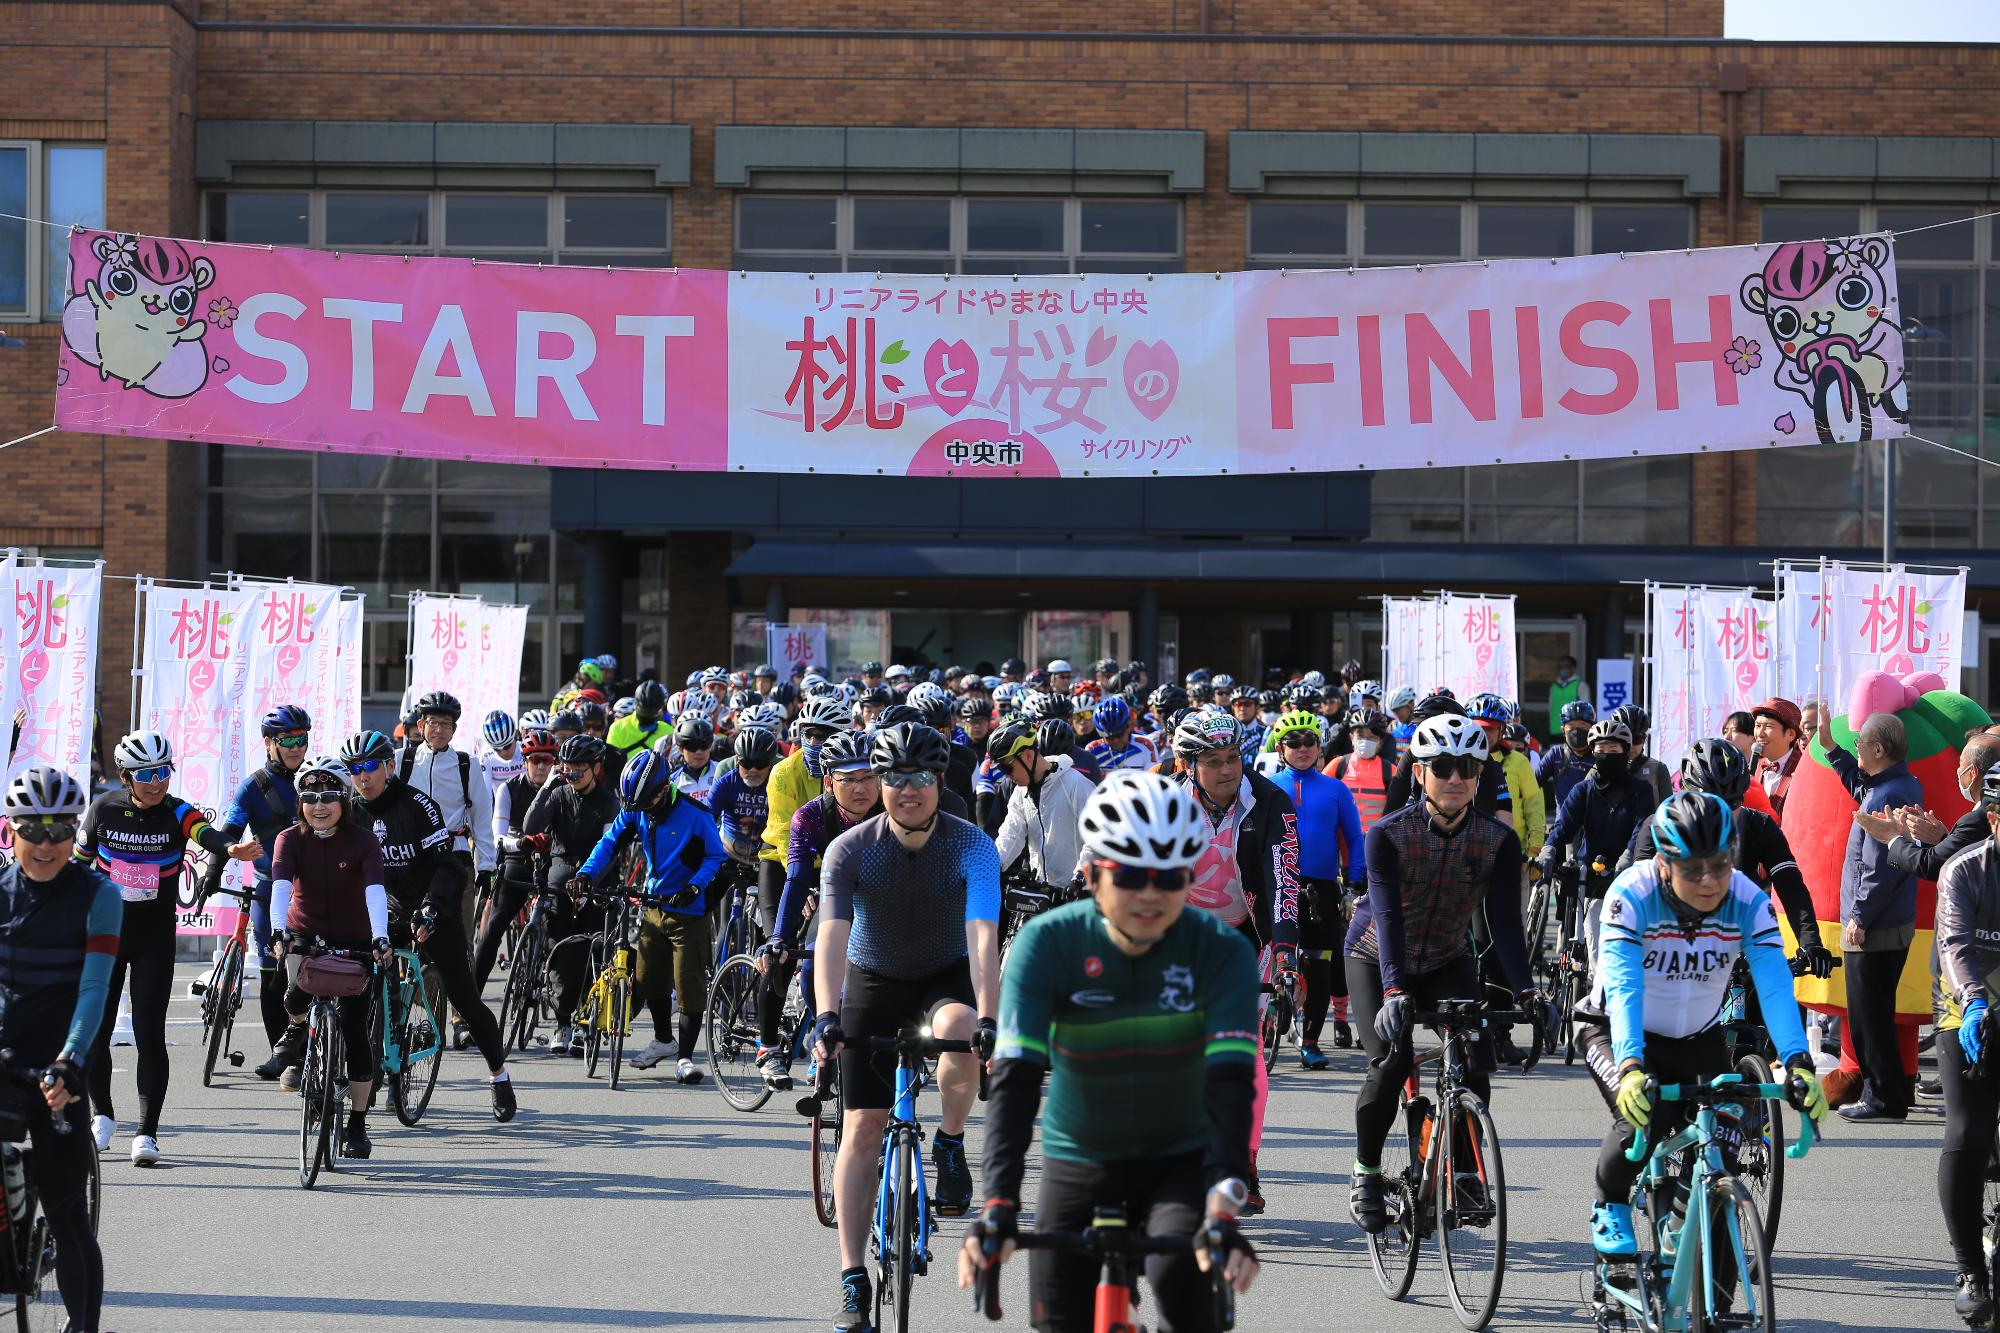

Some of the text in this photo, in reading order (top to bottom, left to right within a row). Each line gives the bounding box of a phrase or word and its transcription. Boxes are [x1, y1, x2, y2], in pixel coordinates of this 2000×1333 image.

[814, 287, 1149, 316] リニアライドやまなし中央
[223, 292, 695, 426] START
[1266, 294, 1740, 430] FINISH
[785, 315, 1171, 435] 桃と桜の
[946, 440, 1023, 466] 中央市
[1080, 436, 1192, 461] サイクリング
[413, 793, 440, 826] BIANCHI
[106, 829, 170, 844] YAMANASHI
[108, 841, 127, 850] CYCLE
[110, 867, 159, 887] 今中大介
[125, 864, 142, 873] ゲスト
[1666, 972, 1710, 982] MILANO
